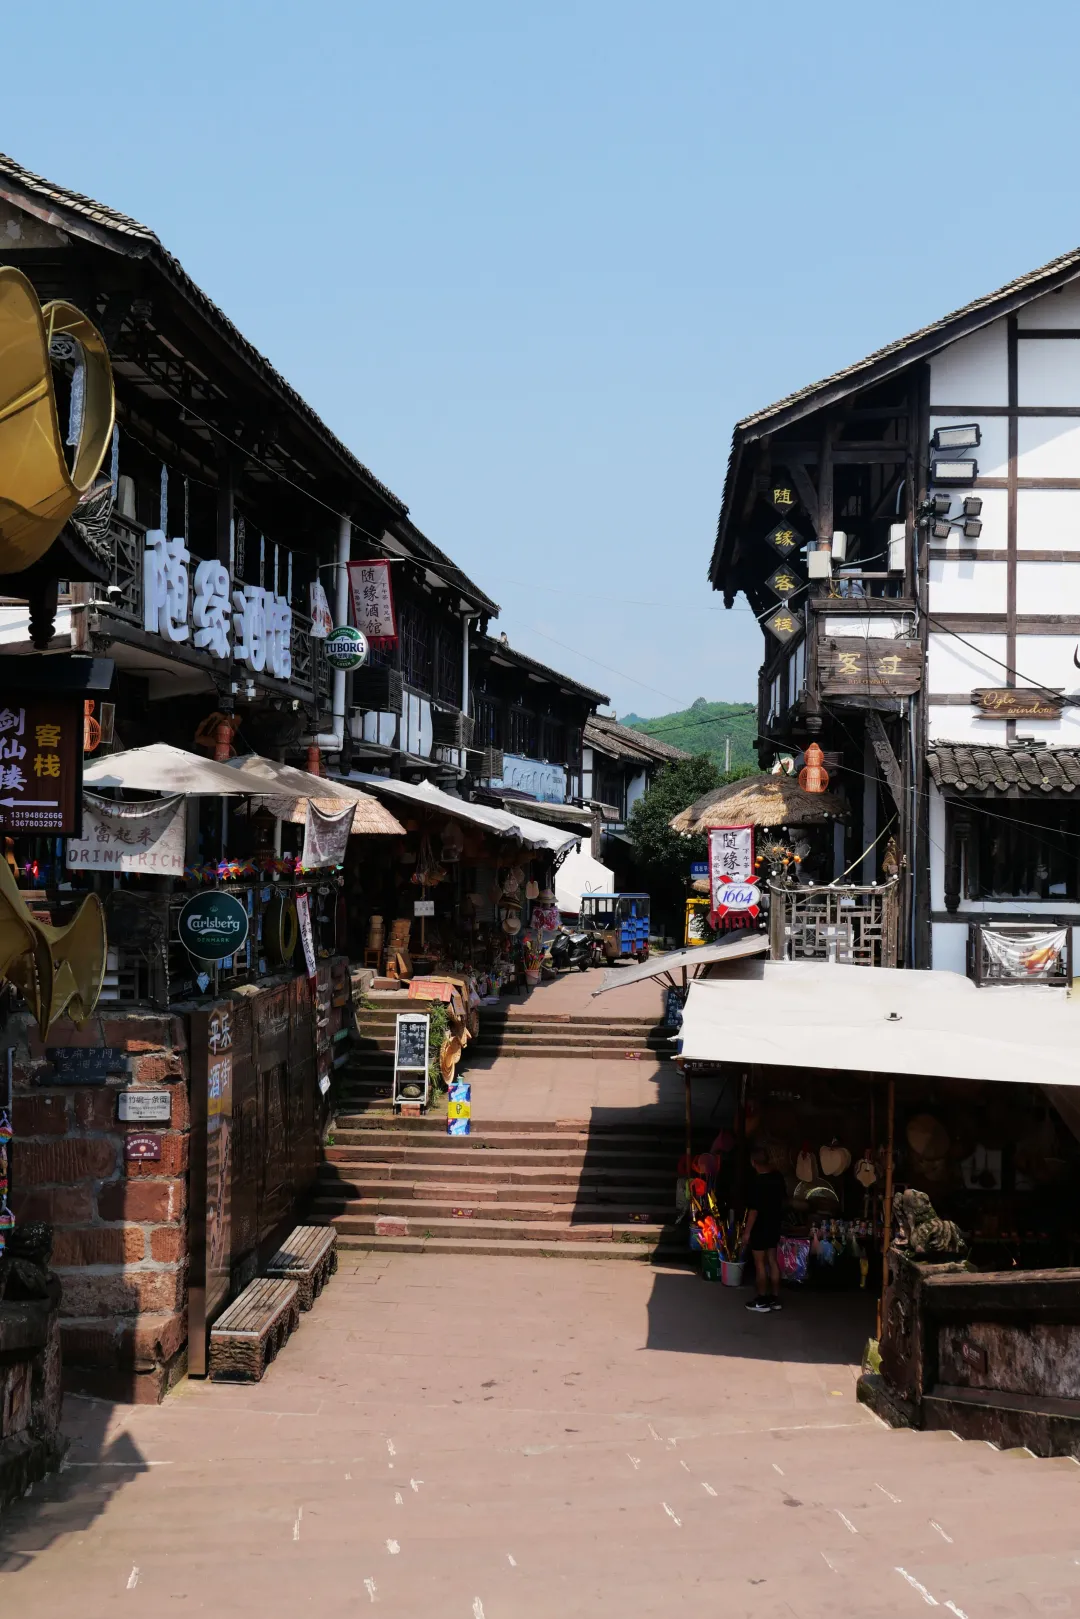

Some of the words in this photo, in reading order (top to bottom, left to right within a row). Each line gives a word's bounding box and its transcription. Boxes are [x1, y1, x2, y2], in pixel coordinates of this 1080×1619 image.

[361, 569, 382, 634] 随缘酒馆
[325, 643, 364, 653] TUBORG
[983, 692, 1015, 709] Ogle
[34, 724, 62, 777] 客栈
[11, 811, 62, 819] 13194862666
[11, 820, 62, 828] 13678032979
[723, 832, 740, 880] 随缘
[722, 889, 753, 904] 1664
[187, 914, 240, 933] Carlsberg
